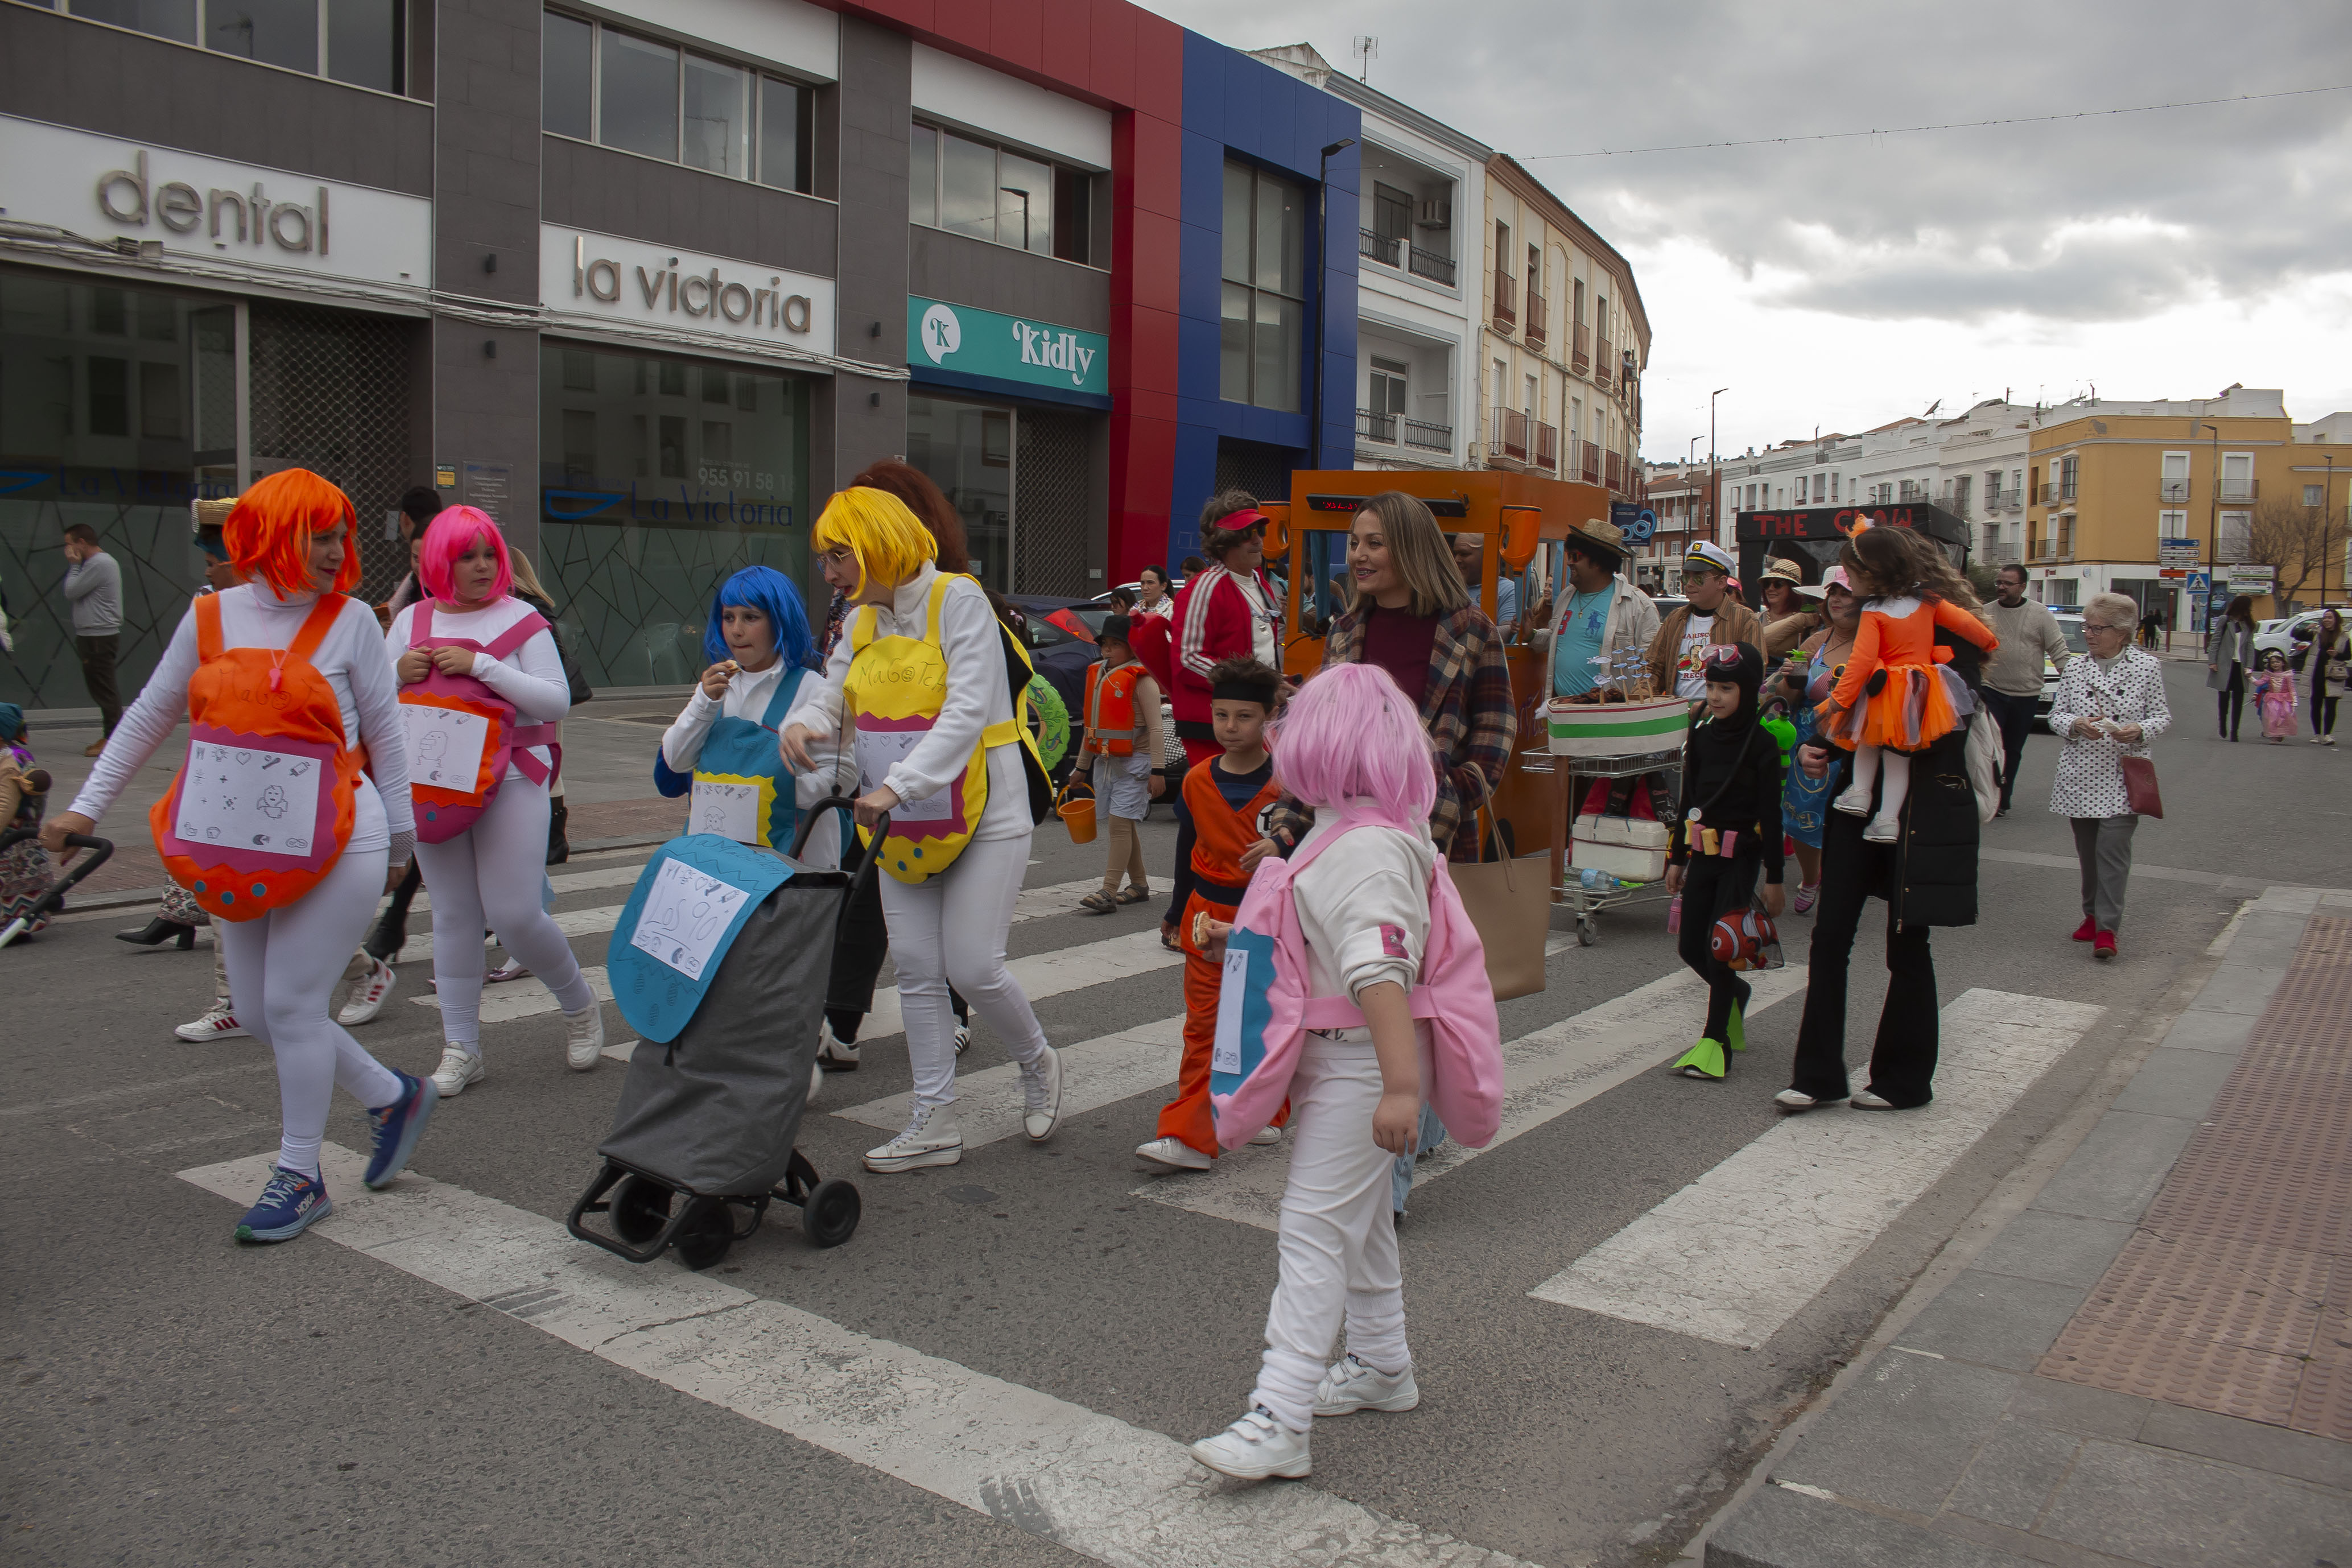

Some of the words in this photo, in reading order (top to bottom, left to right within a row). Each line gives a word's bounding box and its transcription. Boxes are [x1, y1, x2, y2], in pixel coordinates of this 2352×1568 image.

[98, 150, 329, 255] dental
[575, 235, 621, 302] la
[636, 256, 812, 333] victoria
[930, 317, 951, 348] K
[1012, 320, 1096, 386] Kidly
[698, 467, 728, 487] 955
[733, 470, 750, 489] 91
[755, 472, 774, 491] 58
[632, 481, 670, 521] La
[680, 484, 793, 527] Victoria
[1752, 514, 1808, 536] THE
[1833, 508, 1912, 533] CAW
[294, 1191, 316, 1217] HOKA
